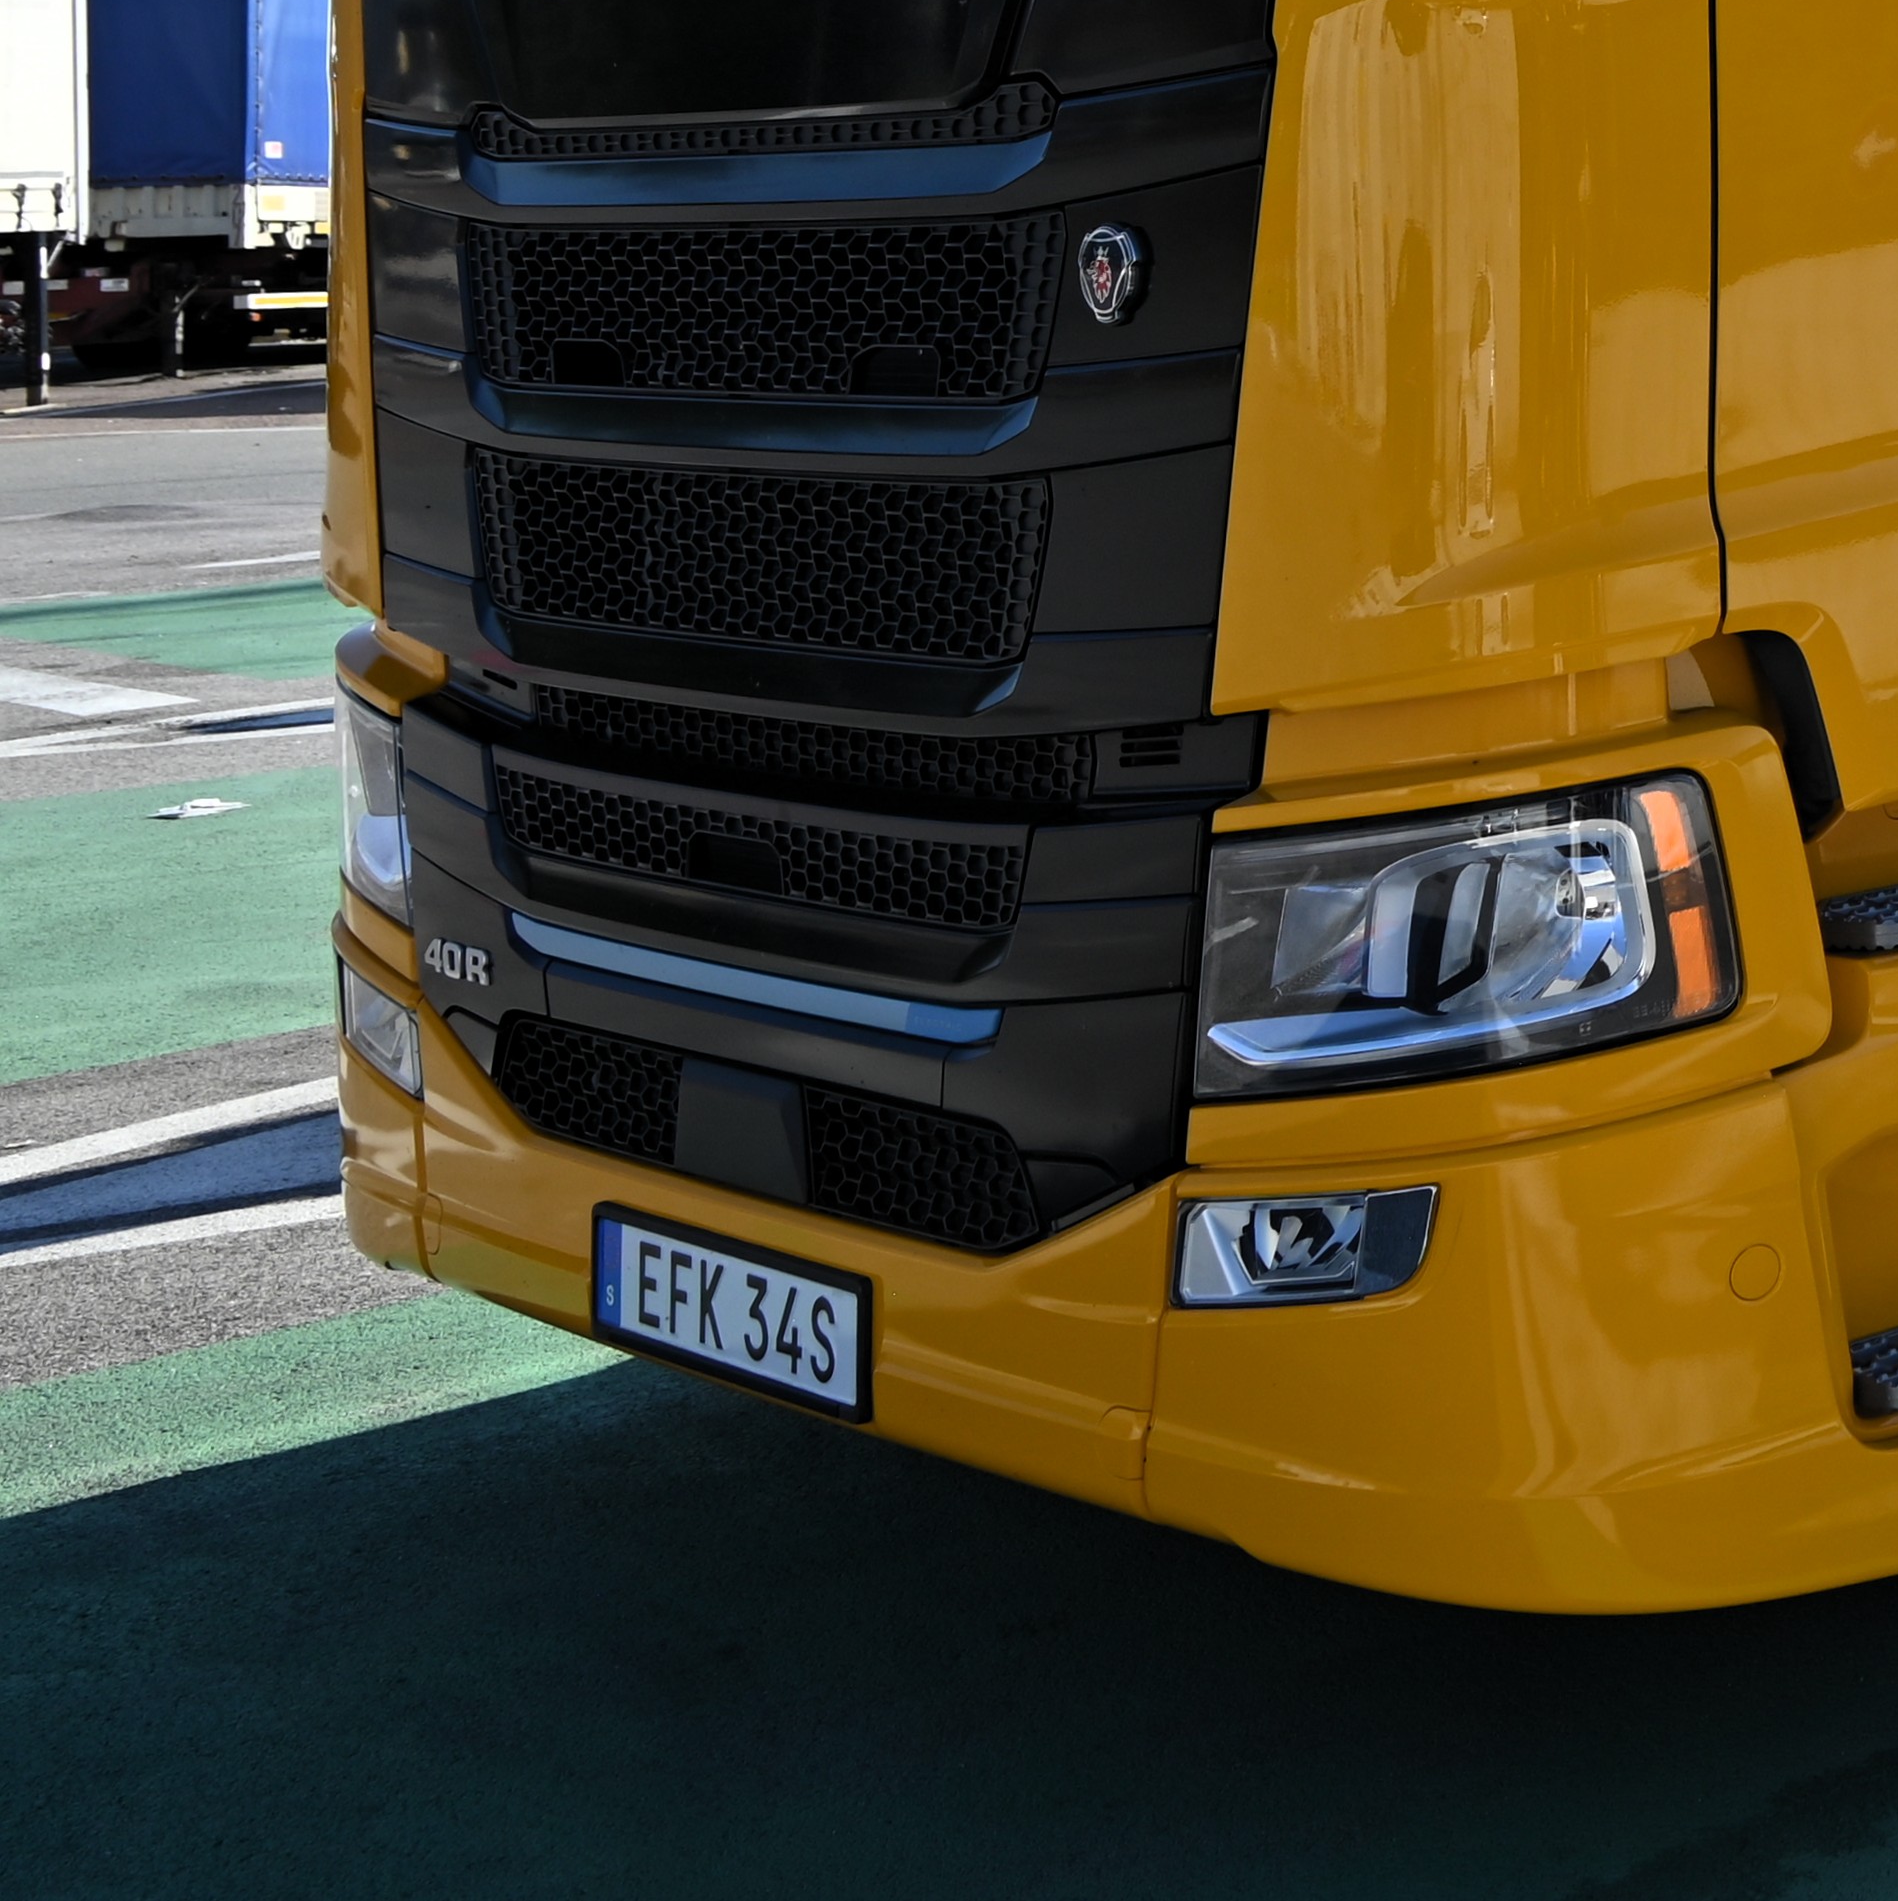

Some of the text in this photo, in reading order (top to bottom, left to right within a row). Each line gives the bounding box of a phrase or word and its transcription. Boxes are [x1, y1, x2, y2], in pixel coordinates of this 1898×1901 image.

[424, 938, 489, 986] 40R
[606, 1284, 614, 1306] S
[639, 1240, 836, 1384] EFK 34S
